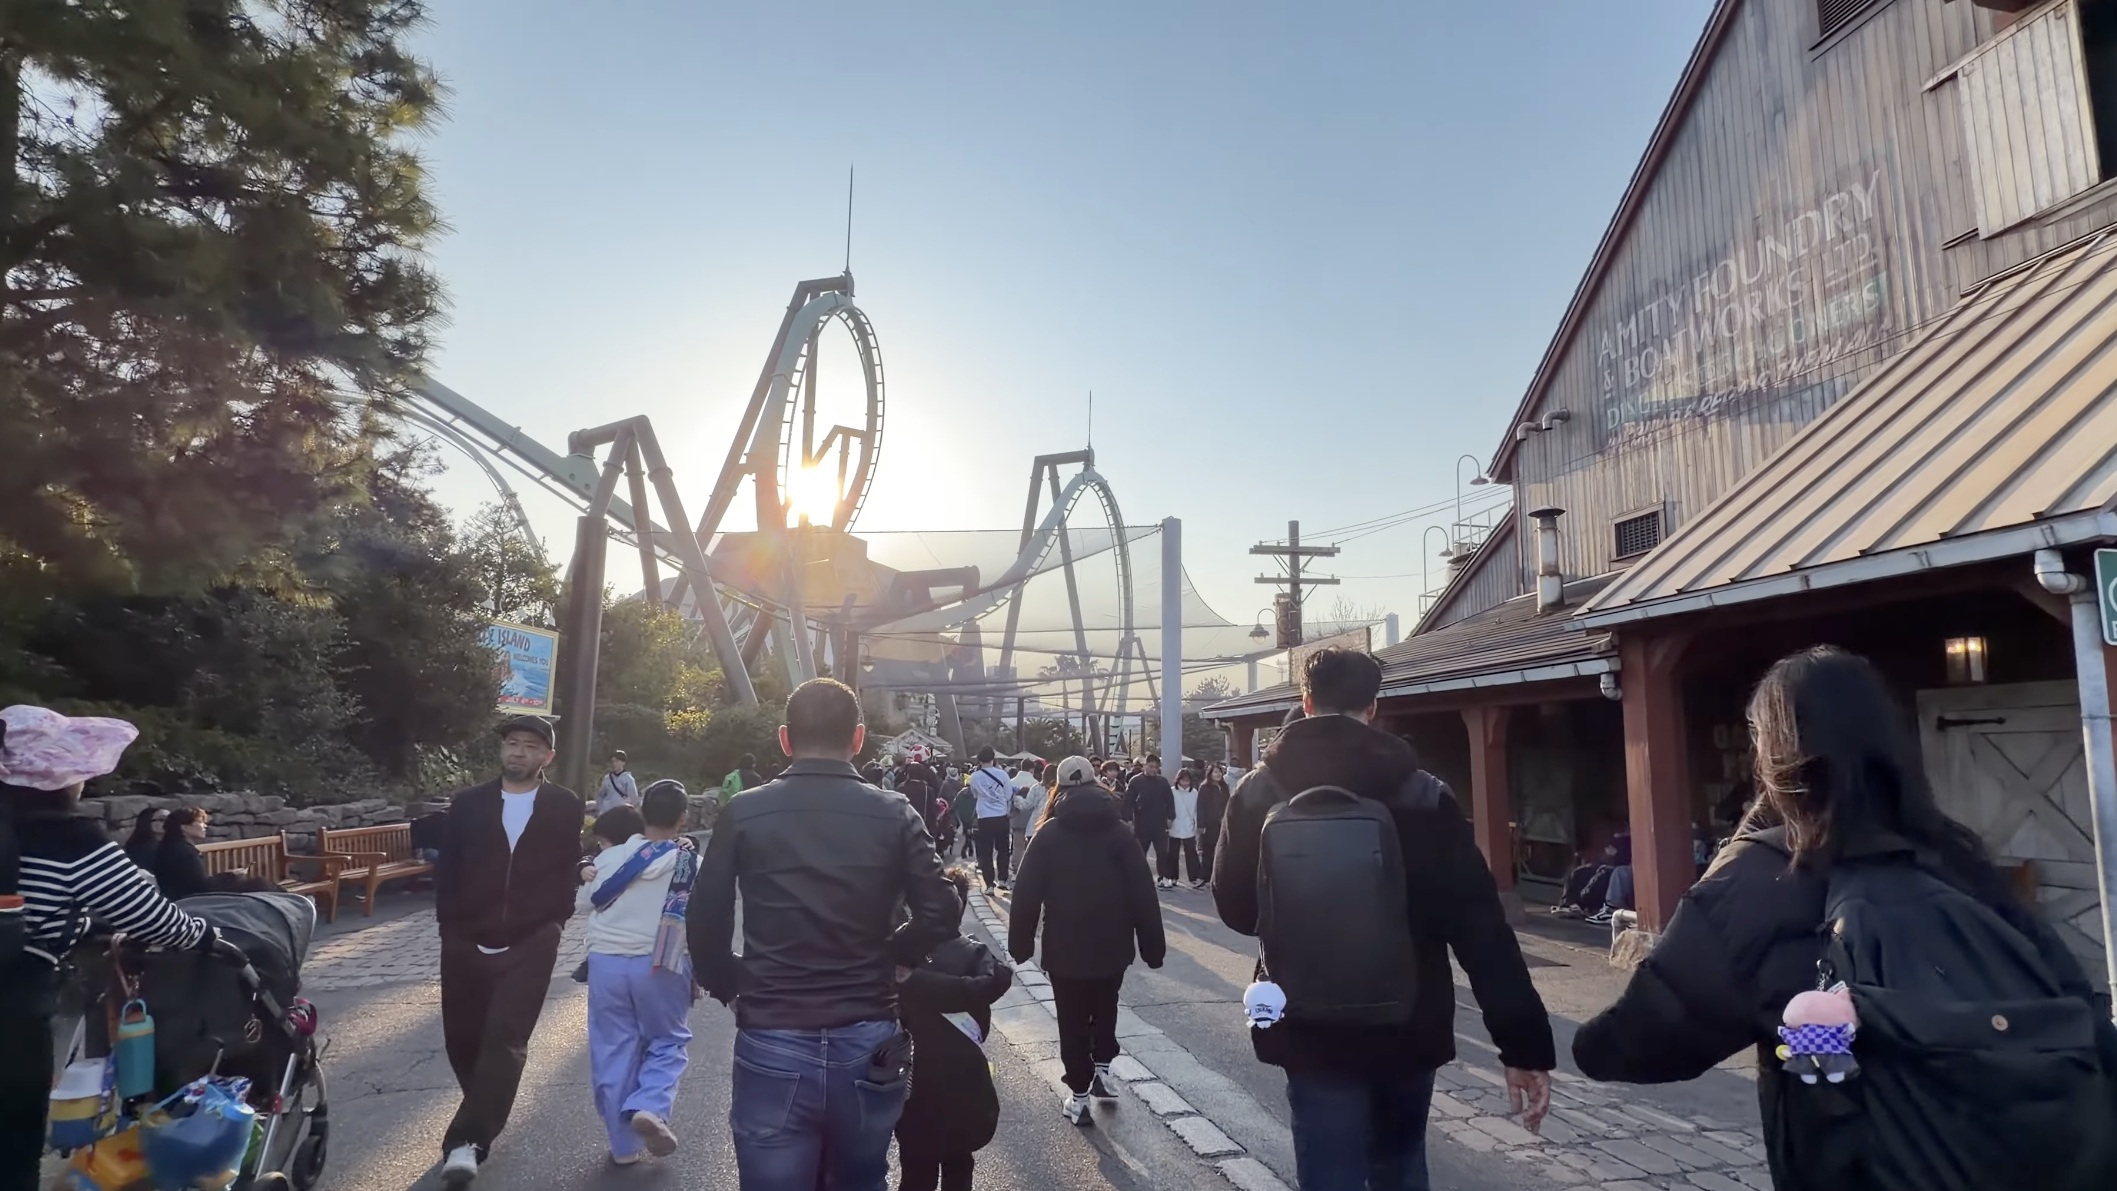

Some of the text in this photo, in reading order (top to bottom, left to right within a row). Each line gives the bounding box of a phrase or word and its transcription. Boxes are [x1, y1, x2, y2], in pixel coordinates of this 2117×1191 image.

[1598, 168, 1880, 366] AMITY FOUNDRY
[1603, 366, 1615, 399] &
[498, 628, 531, 652] ISLAND
[513, 653, 550, 666] WELCOMES YOU
